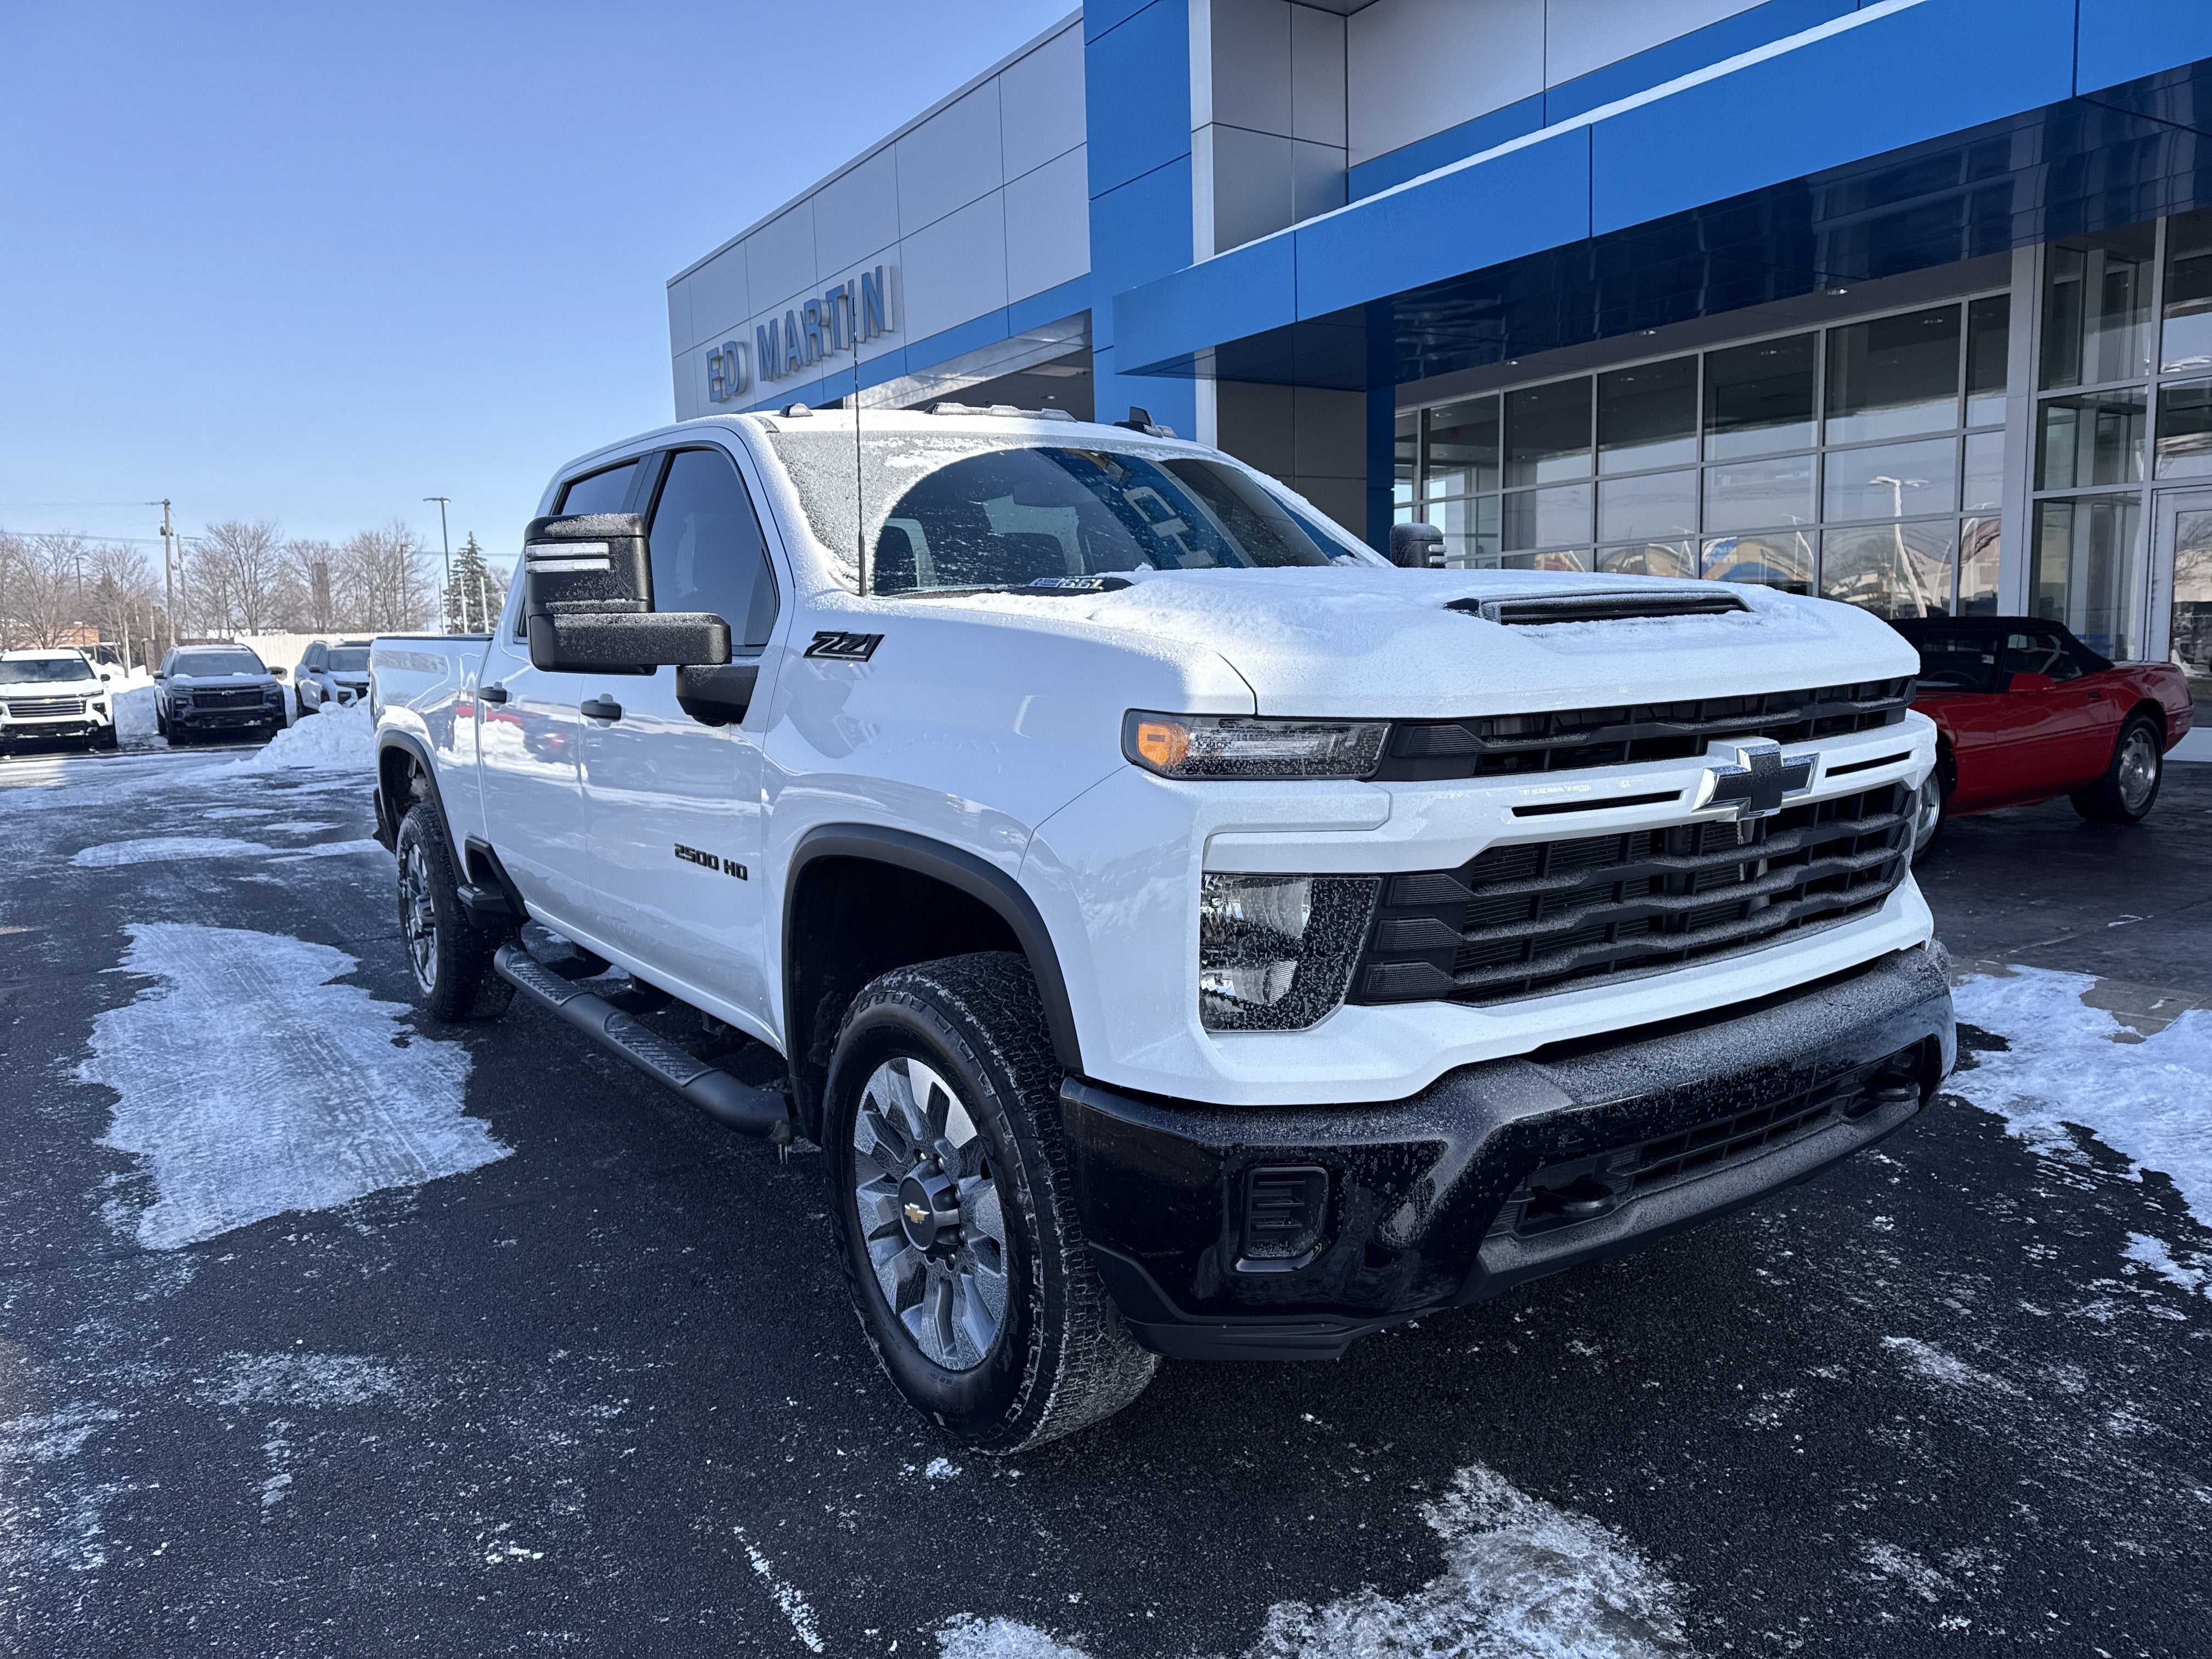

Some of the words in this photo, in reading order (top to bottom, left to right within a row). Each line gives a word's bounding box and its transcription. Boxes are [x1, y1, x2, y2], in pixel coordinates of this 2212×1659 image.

[706, 340, 744, 403] ED
[756, 265, 892, 381] MARTIN
[803, 630, 885, 662] Z71
[674, 843, 719, 871] 2500
[724, 859, 748, 881] HD
